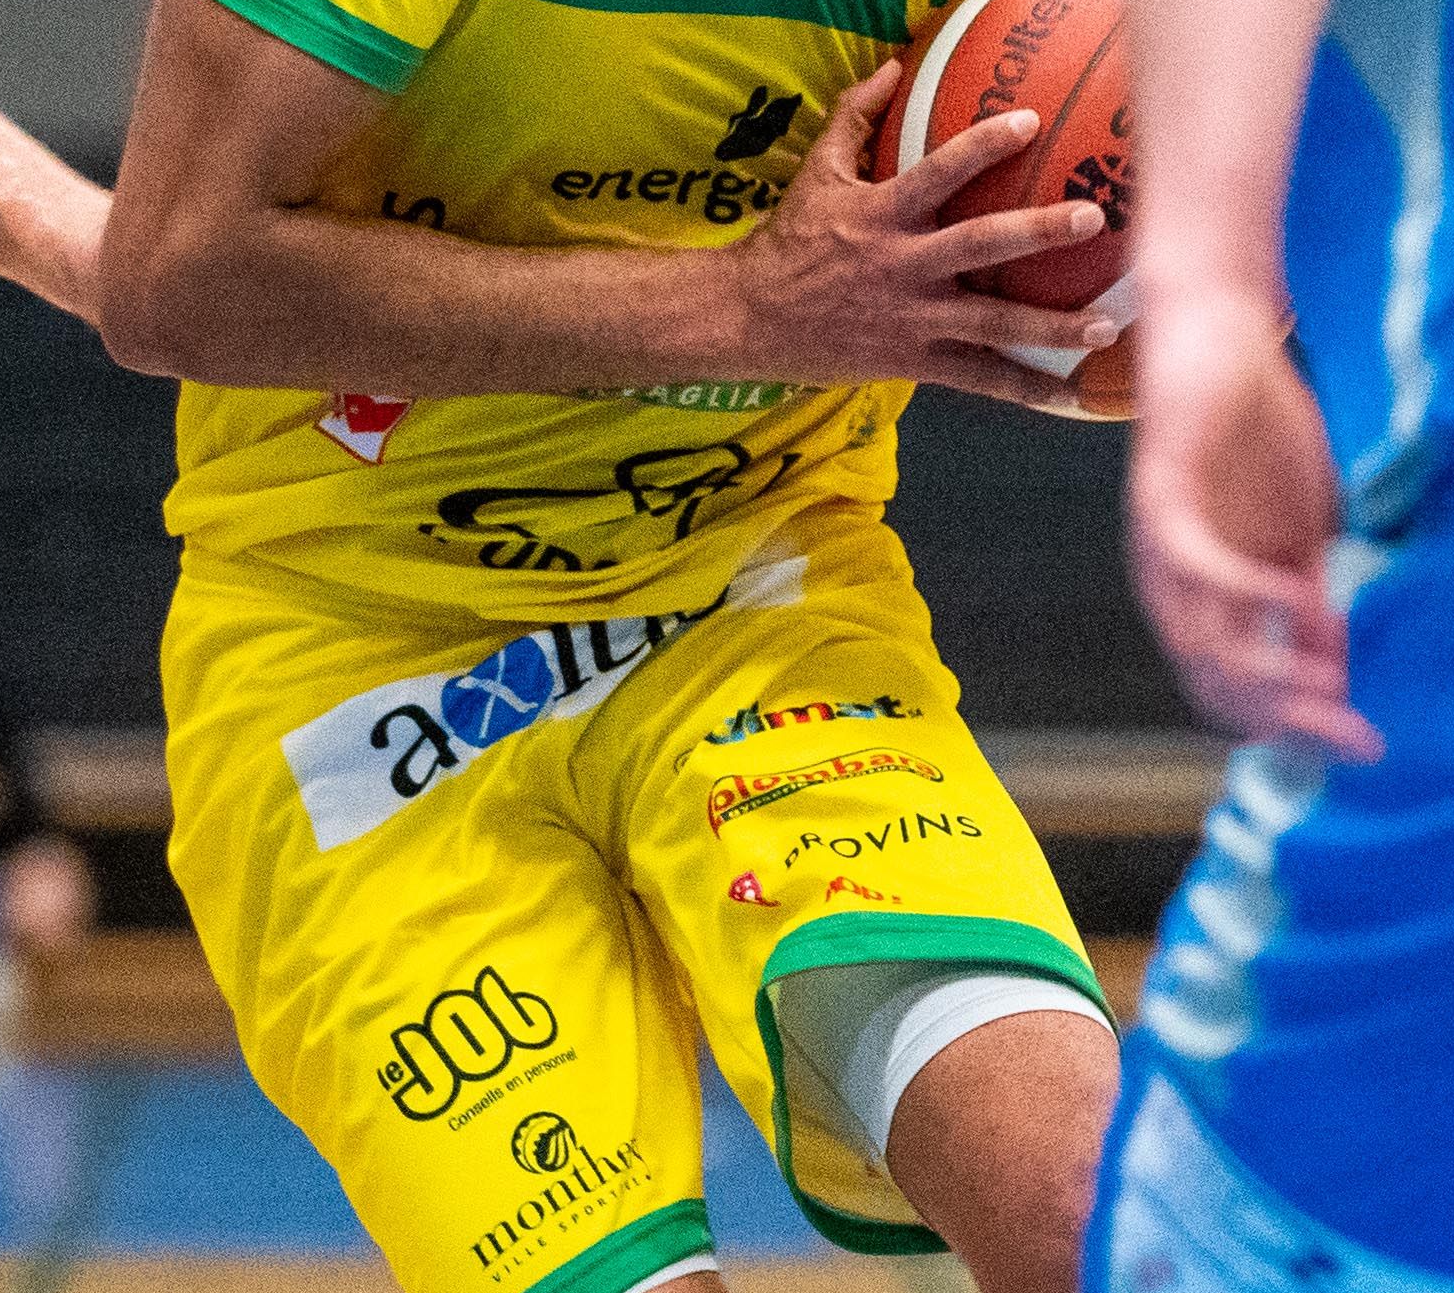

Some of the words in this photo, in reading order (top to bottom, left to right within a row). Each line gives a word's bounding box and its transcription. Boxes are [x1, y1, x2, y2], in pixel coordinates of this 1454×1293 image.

[550, 166, 789, 224] energi
[785, 812, 983, 869] PROVINS
[377, 1061, 404, 1091] le
[448, 1087, 505, 1132] Conseils
[505, 1075, 524, 1092] en
[523, 1047, 578, 1083] personnel
[491, 1237, 547, 1283] VILLE
